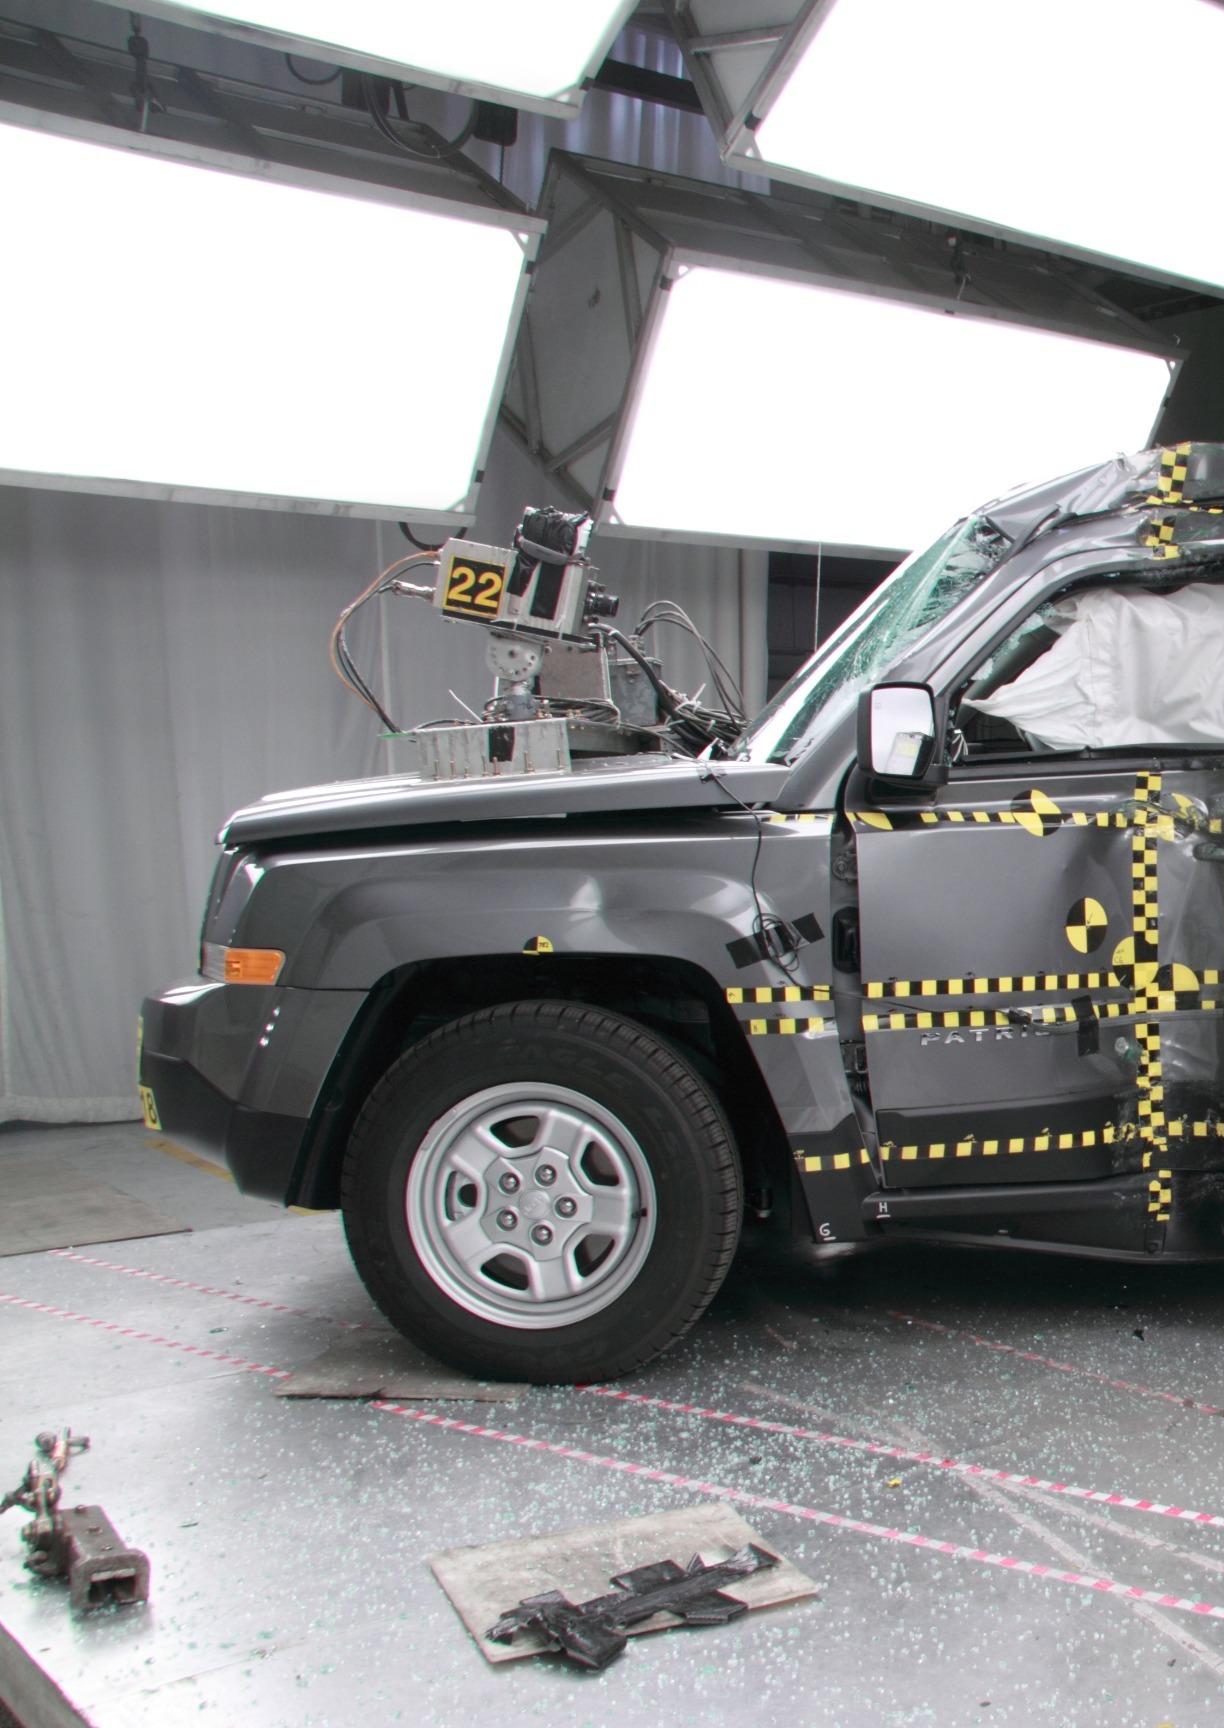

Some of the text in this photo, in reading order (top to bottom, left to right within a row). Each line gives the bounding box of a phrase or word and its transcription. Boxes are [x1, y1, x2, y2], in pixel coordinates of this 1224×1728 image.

[447, 566, 503, 608] 22
[920, 1024, 1050, 1046] PATRI
[878, 1202, 888, 1213] H
